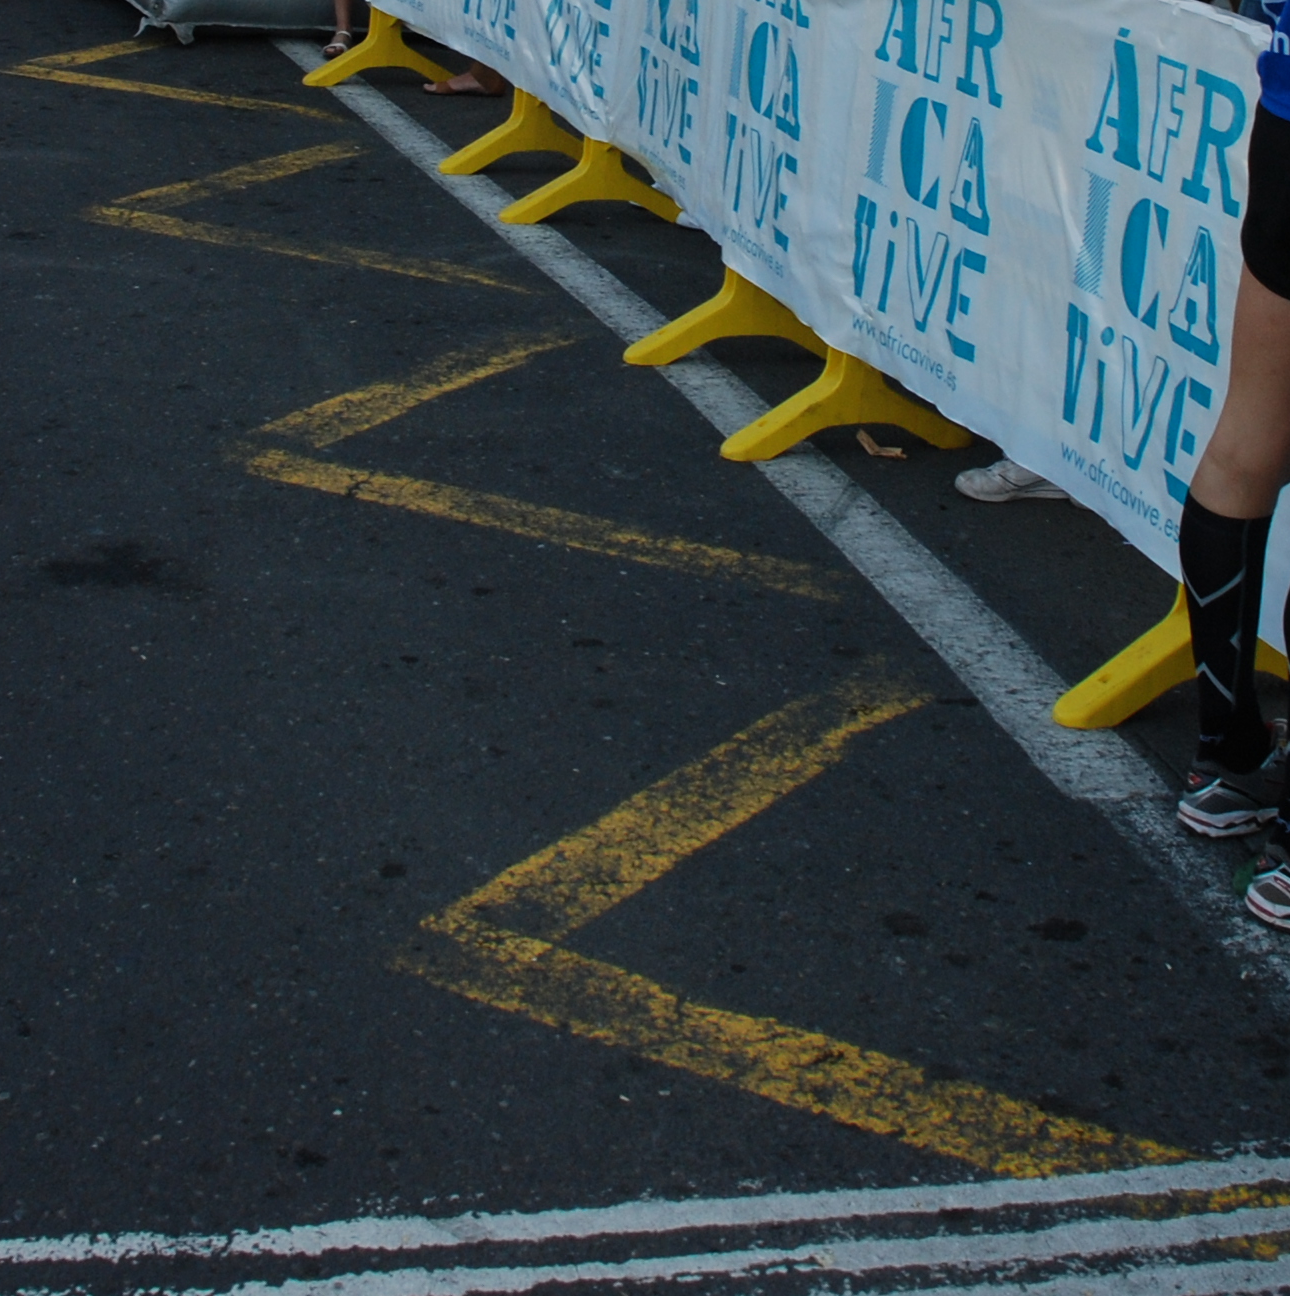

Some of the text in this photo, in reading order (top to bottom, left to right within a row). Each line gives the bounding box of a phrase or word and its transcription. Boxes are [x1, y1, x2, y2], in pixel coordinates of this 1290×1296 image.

[729, 4, 800, 141] ICA
[865, 77, 991, 236] ICA
[1085, 28, 1247, 218] ÁFR
[1073, 169, 1220, 366] ICA
